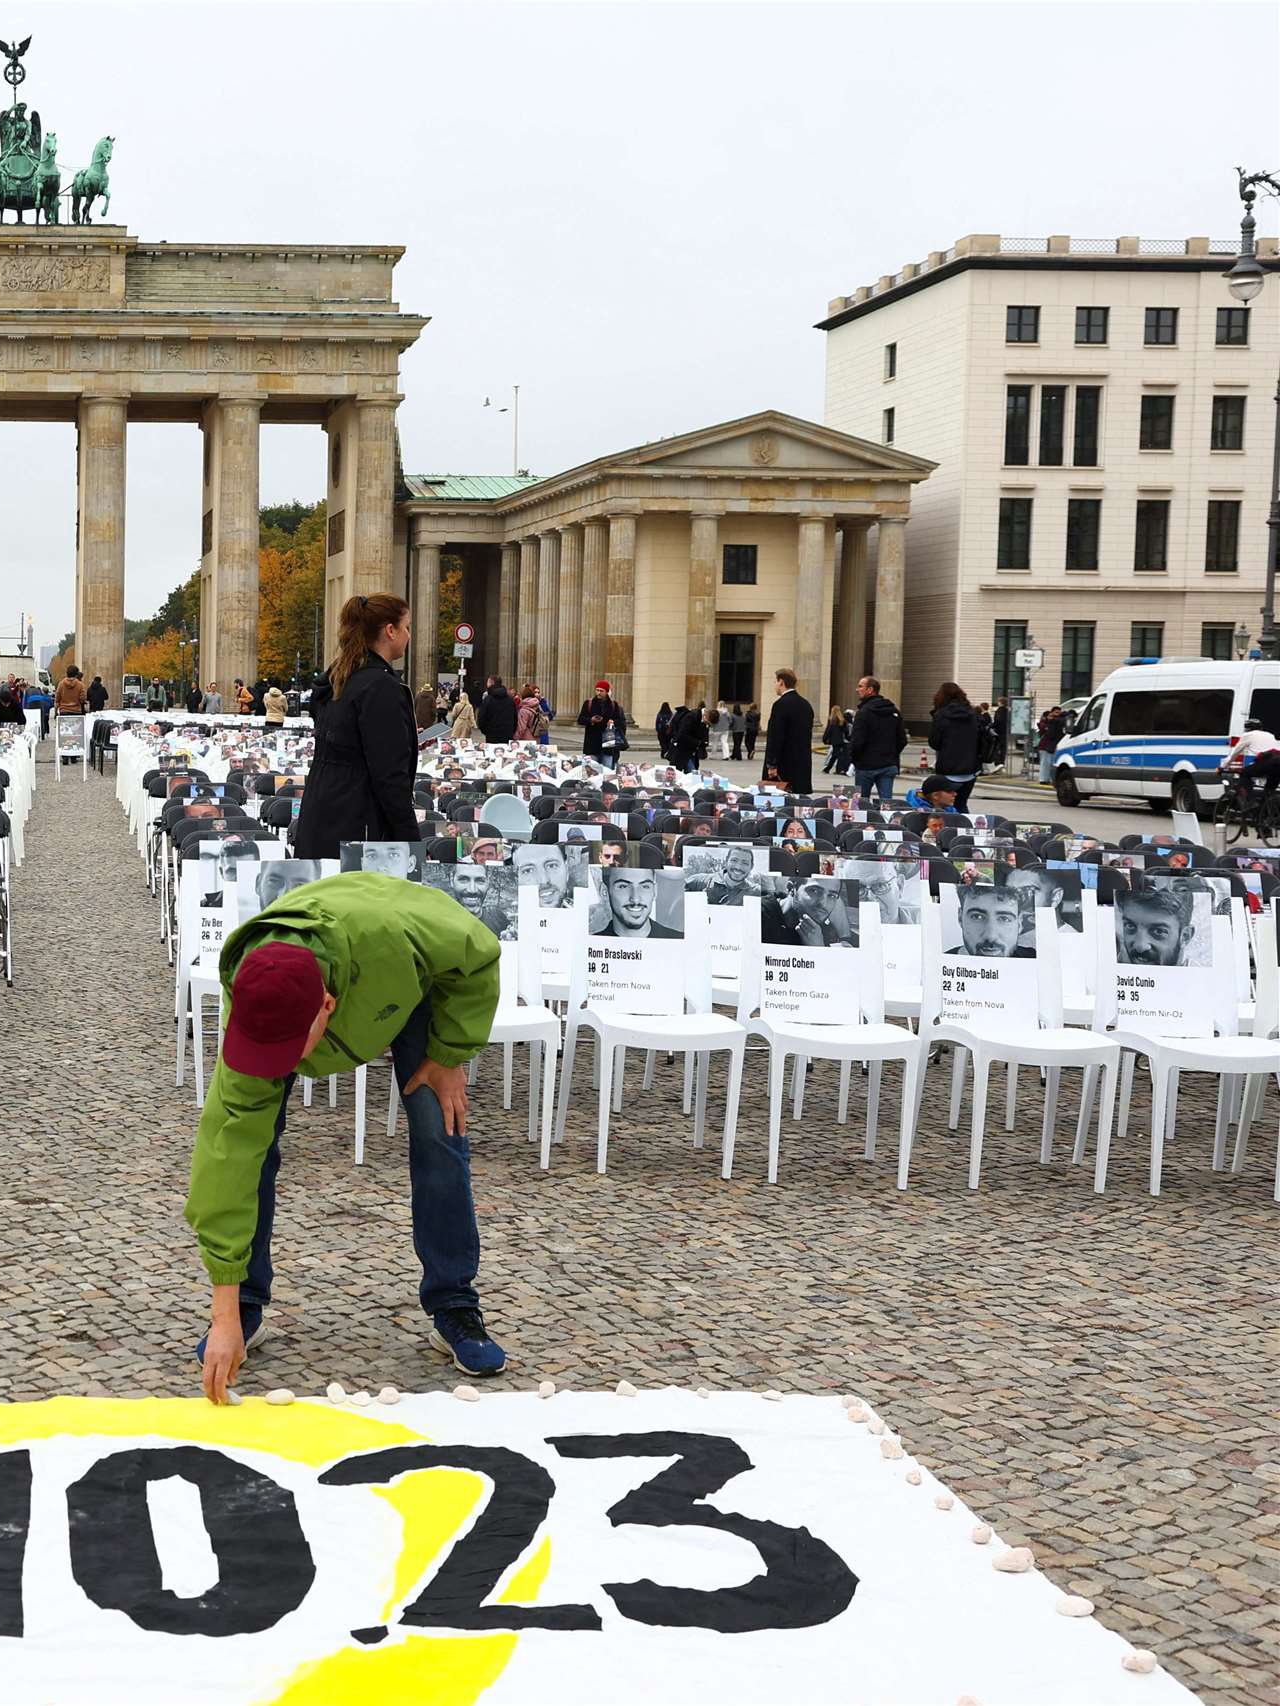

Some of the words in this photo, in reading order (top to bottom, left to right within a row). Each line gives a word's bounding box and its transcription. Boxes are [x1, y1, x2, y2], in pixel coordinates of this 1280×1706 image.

[202, 918, 211, 927] Ziv
[588, 948, 603, 958] Rom
[605, 948, 642, 960] Braslavski
[766, 956, 790, 967] Nimrod
[792, 957, 814, 969] Cohen
[601, 964, 609, 973] 21
[943, 966, 954, 979] Guy
[956, 967, 999, 979] Gilboa-Dalal
[779, 972, 788, 982] 20
[1117, 976, 1134, 987] David
[1136, 977, 1155, 988] Cunio
[610, 981, 629, 989] from
[631, 982, 651, 990] Nova
[956, 982, 965, 992] 24
[766, 988, 787, 997] Taken
[789, 990, 807, 998] from
[810, 991, 829, 999] Gaza
[1131, 991, 1139, 1001] 35
[765, 1002, 800, 1010] Envelope
[944, 998, 964, 1007] Taken
[966, 999, 982, 1008] from
[985, 1001, 1004, 1009] Nova
[943, 1012, 969, 1020] Festival
[1117, 1008, 1137, 1016] Taken
[1159, 1010, 1182, 1018] Nir-Oz
